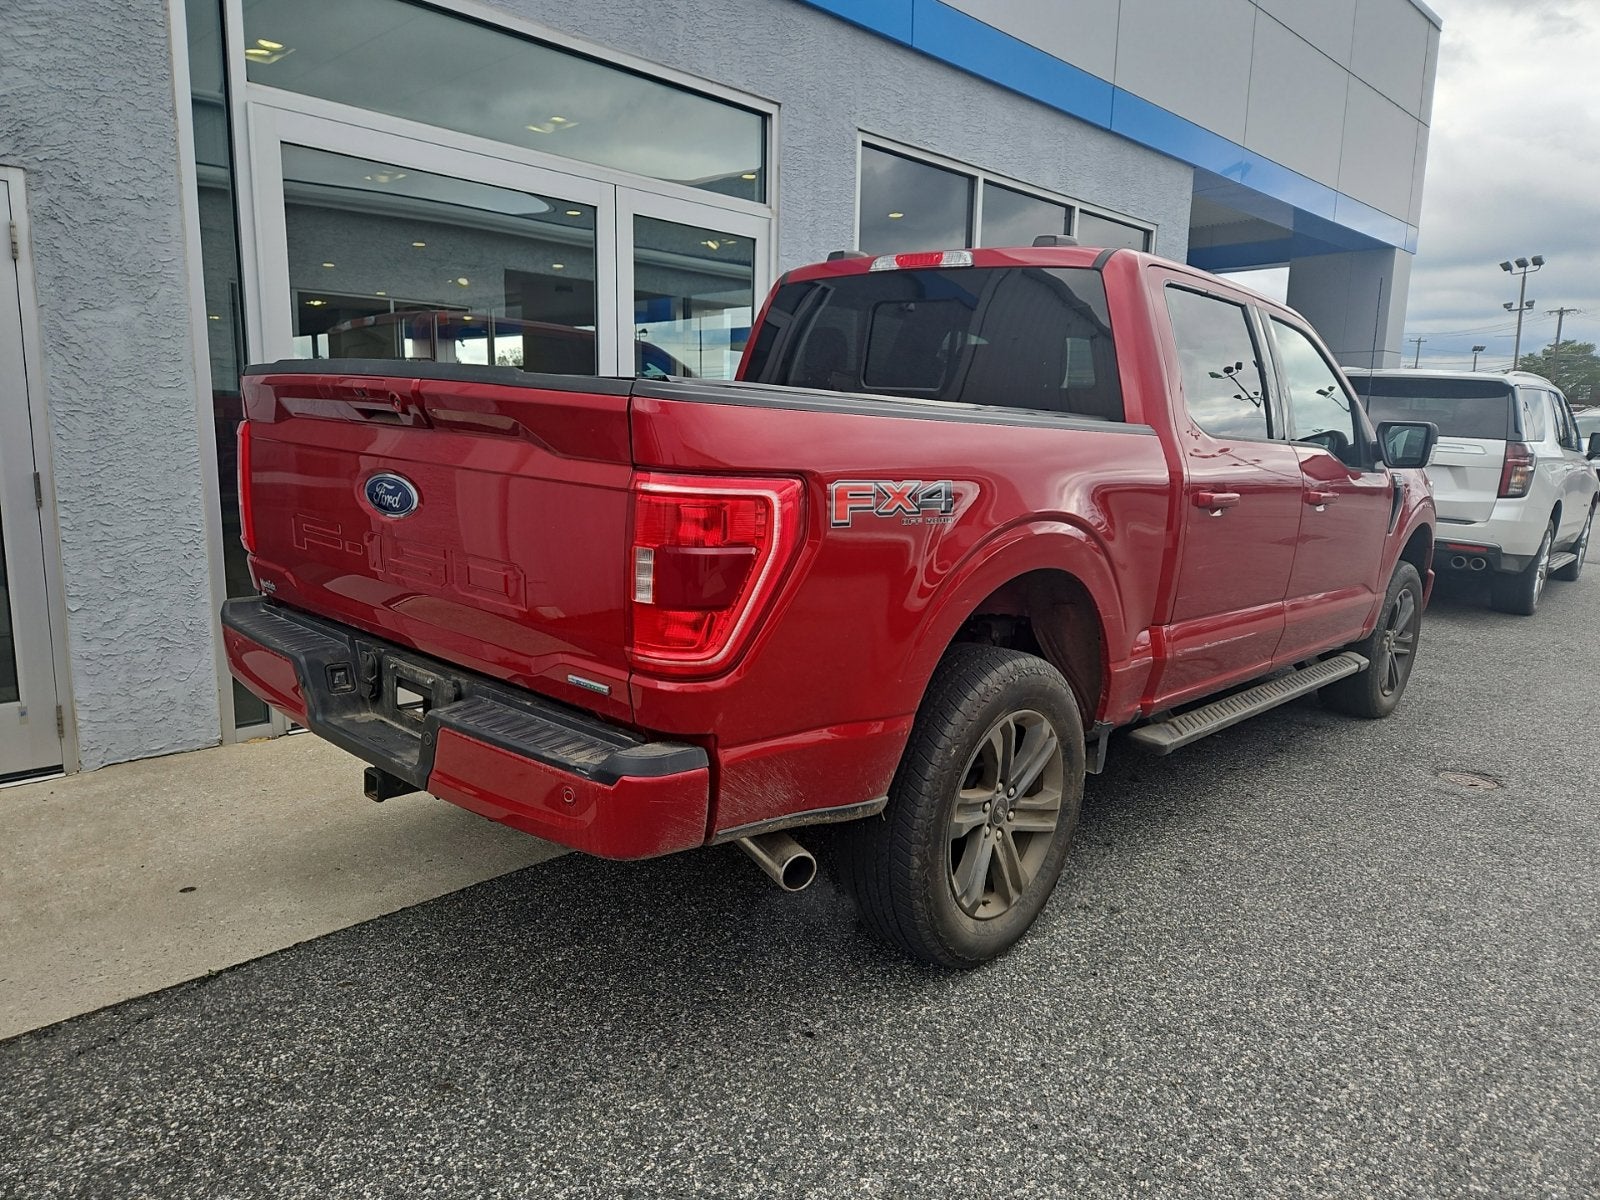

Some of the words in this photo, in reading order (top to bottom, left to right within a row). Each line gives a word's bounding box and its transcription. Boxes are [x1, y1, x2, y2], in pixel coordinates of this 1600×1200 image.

[373, 482, 402, 508] Ford
[831, 480, 954, 528] FX4
[291, 513, 528, 612] F-150
